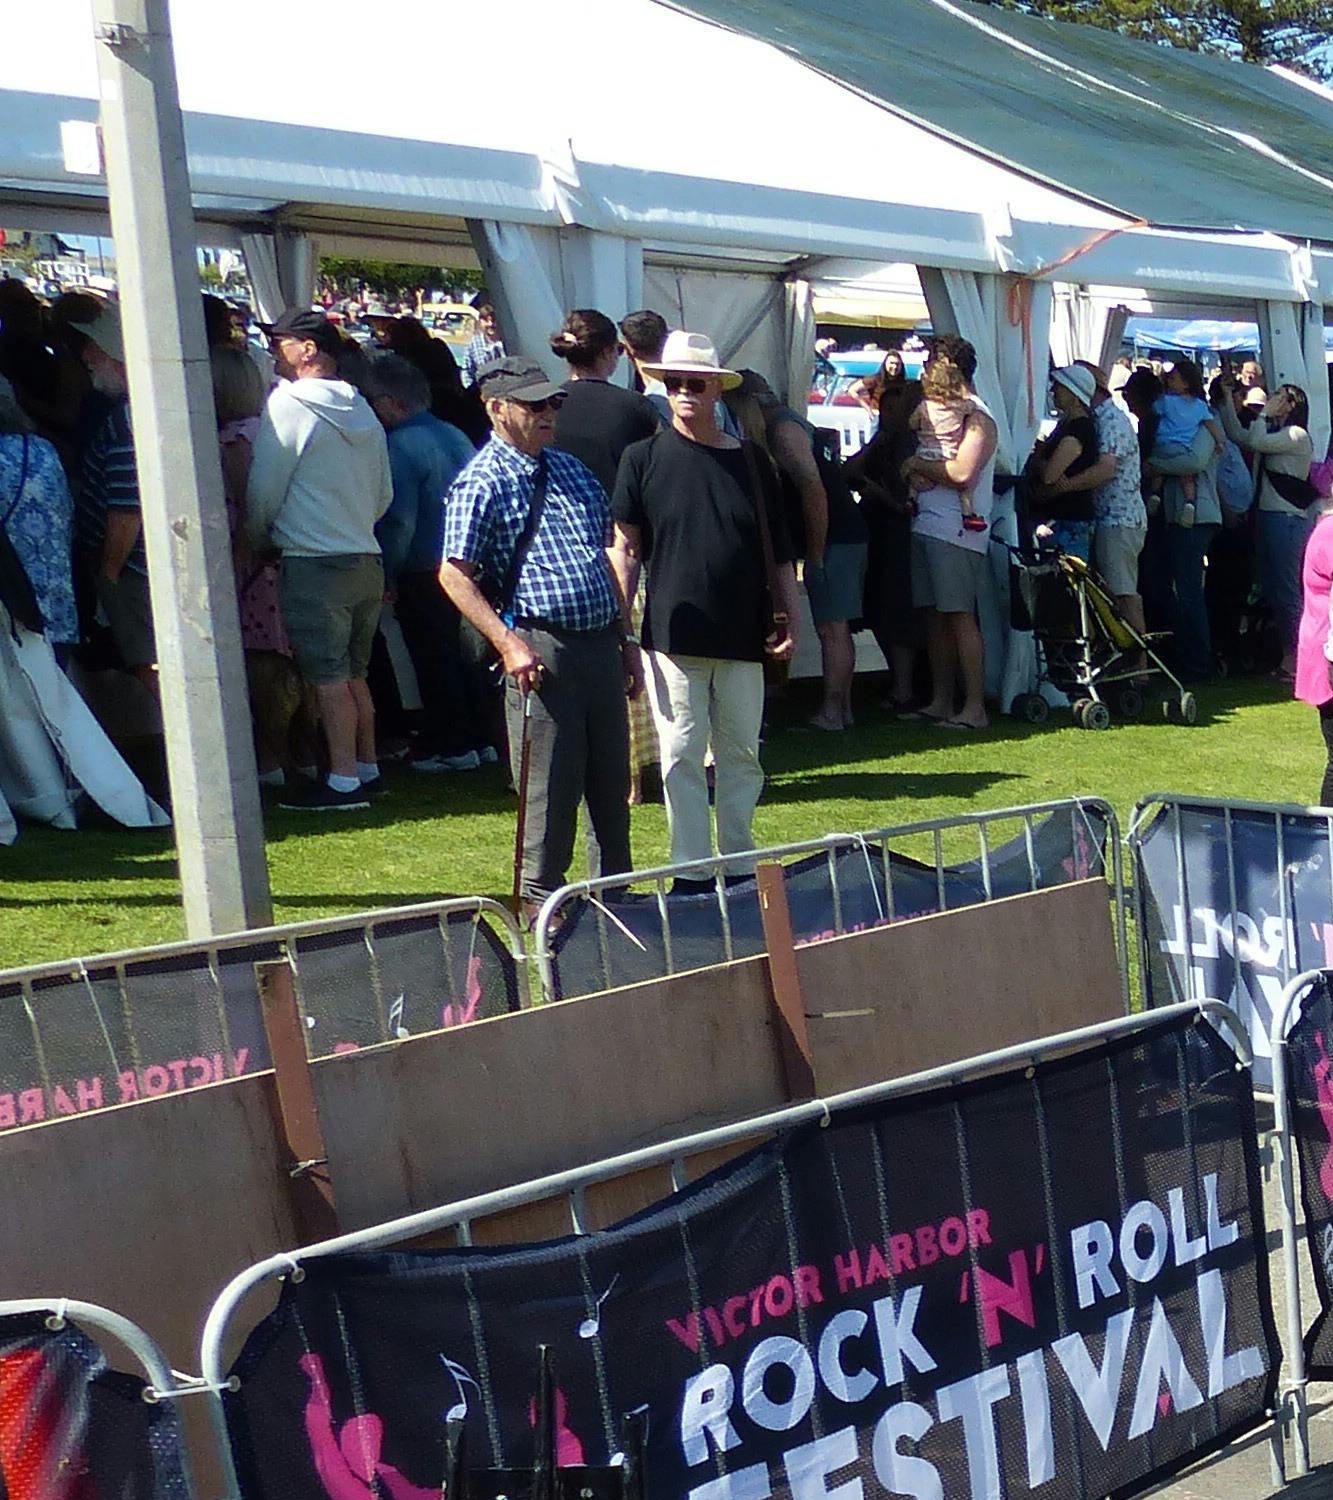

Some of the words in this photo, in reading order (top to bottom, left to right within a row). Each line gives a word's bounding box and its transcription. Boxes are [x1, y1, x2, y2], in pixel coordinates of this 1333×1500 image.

[666, 1265, 823, 1354] VICTOR
[834, 1208, 993, 1294] HARBOR
[681, 1284, 938, 1467] ROCK
[1070, 1172, 1241, 1310] ROLL
